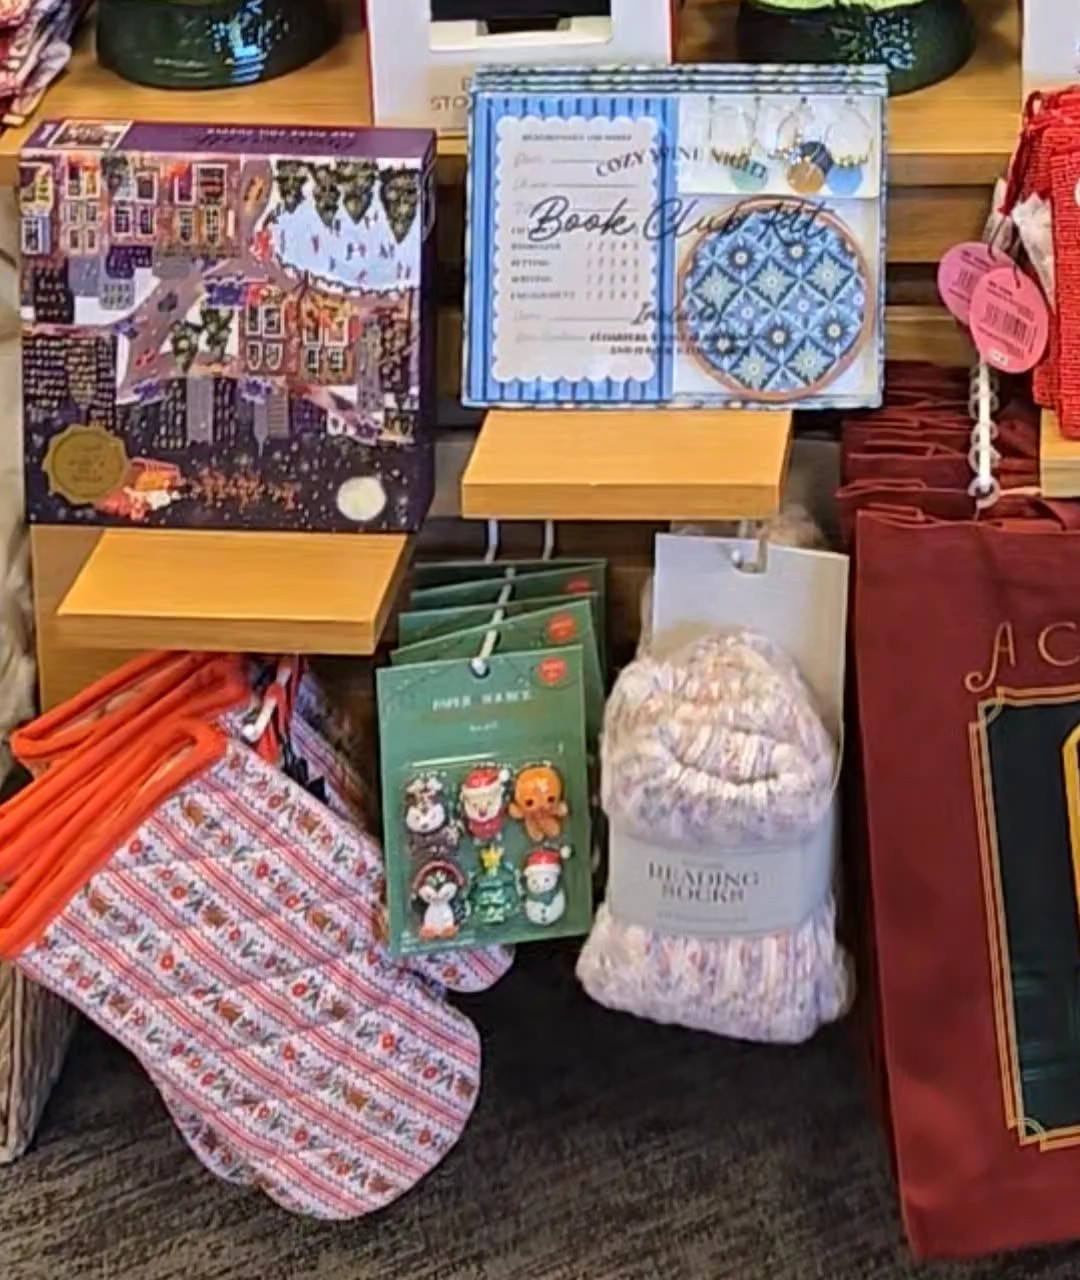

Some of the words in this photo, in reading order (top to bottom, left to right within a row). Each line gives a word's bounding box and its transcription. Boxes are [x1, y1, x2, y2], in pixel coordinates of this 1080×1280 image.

[595, 150, 647, 178] COZY
[528, 195, 638, 242] Book
[642, 197, 743, 241] Club
[756, 199, 836, 246] Kit
[964, 620, 1017, 695] A
[649, 861, 760, 887] READING
[662, 883, 746, 904] SOCKS
